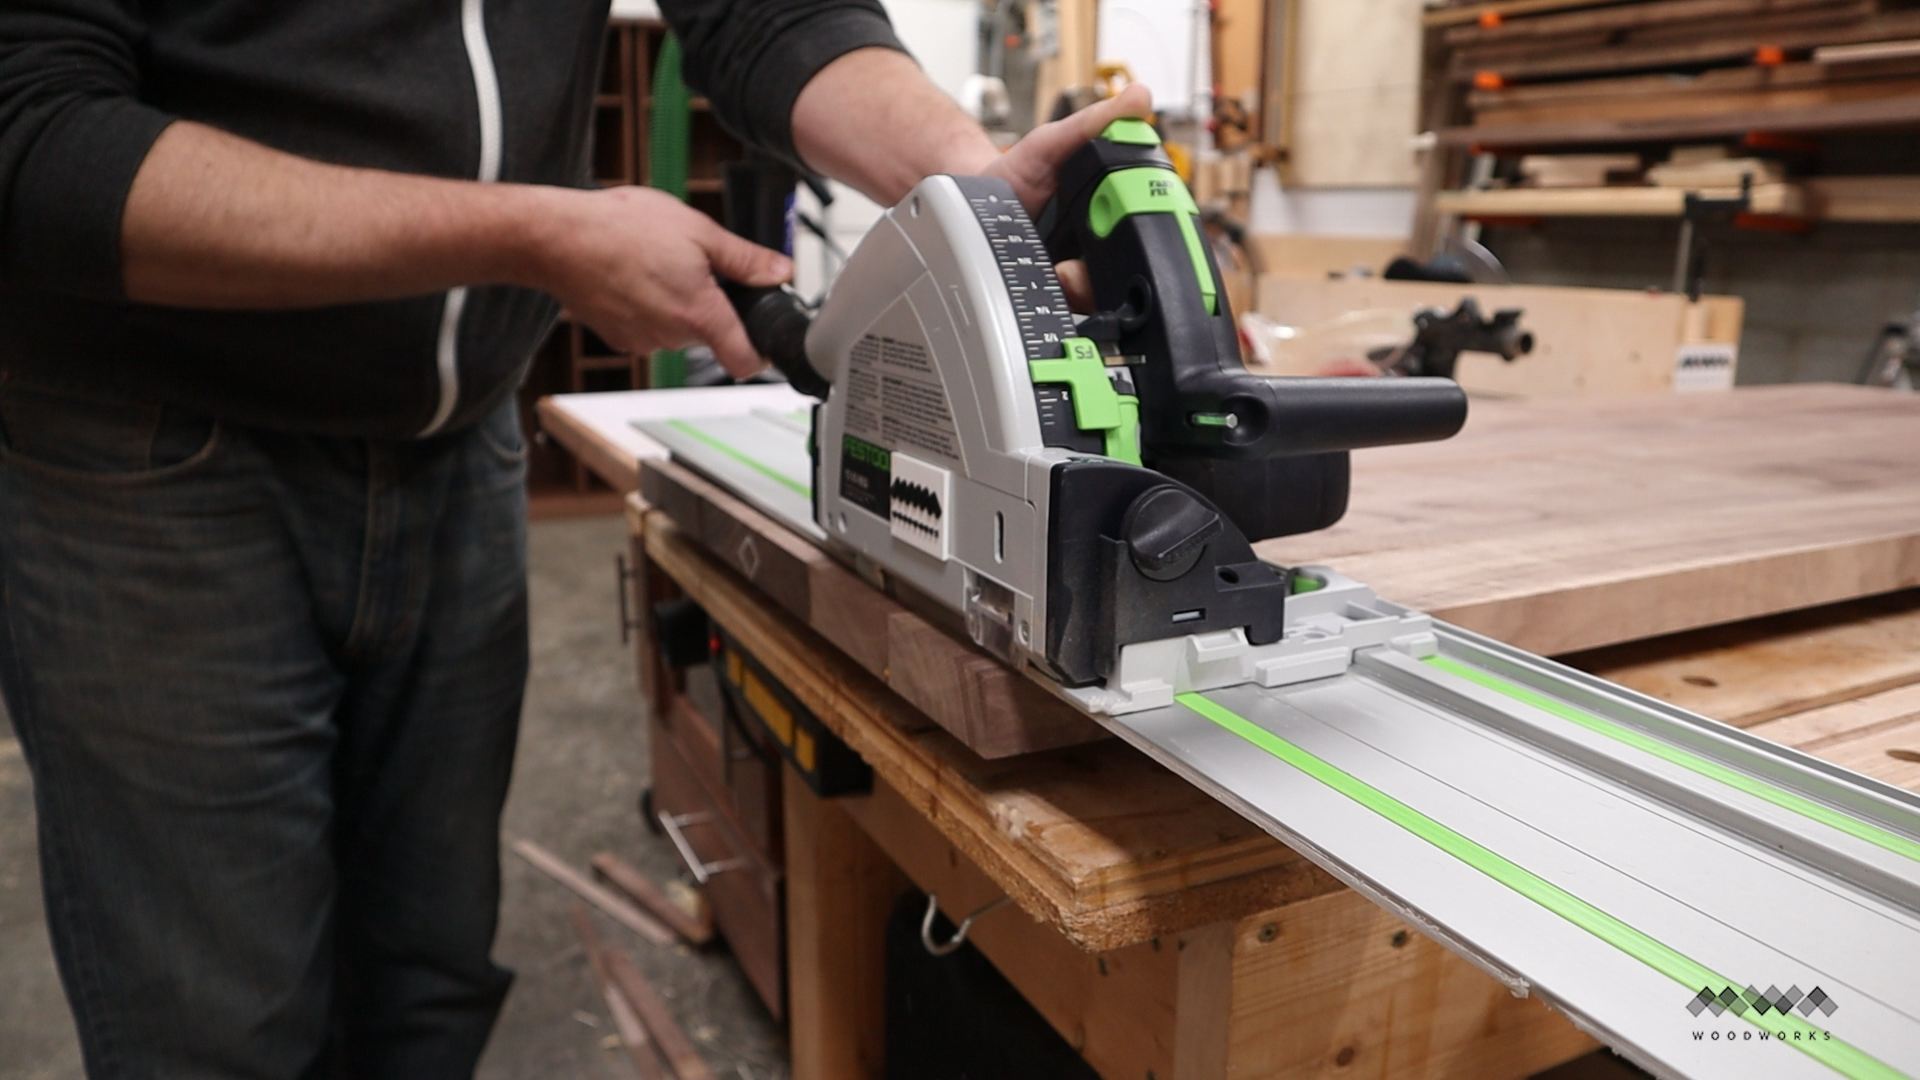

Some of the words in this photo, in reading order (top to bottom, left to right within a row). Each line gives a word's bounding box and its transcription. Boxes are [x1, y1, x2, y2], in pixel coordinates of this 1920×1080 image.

[1043, 332, 1059, 343] 1/2
[1074, 345, 1094, 359] FS
[1061, 390, 1069, 401] 2
[844, 435, 890, 472] FESTOO
